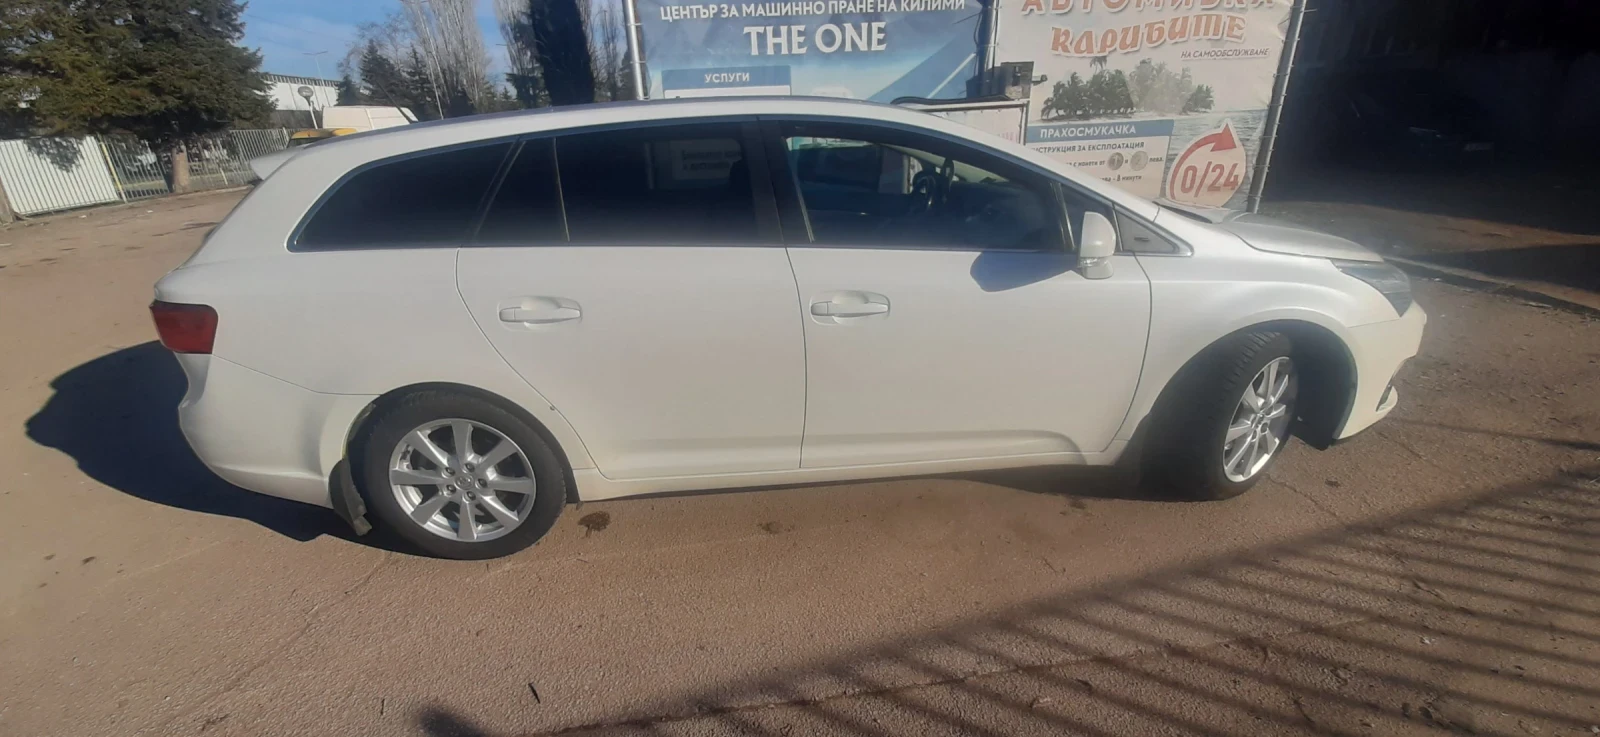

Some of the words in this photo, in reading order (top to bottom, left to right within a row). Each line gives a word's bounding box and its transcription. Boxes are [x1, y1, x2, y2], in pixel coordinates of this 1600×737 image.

[660, 4, 718, 22] ЦЕНТЪР
[720, 3, 739, 18] ЗА
[742, 1, 825, 17] МАШИННО
[828, 0, 875, 14] ПРАНЕ
[877, 0, 898, 12] НА
[901, 0, 965, 11] КИЛИМИ
[743, 24, 808, 55] THE
[815, 21, 887, 53] ONE
[704, 72, 750, 83] УСЛУГИ
[1040, 124, 1136, 138] ПРАХОСМУКАЧКА
[1031, 145, 1076, 153] СТРУКЦИЯ
[1181, 161, 1239, 197] 0/24
